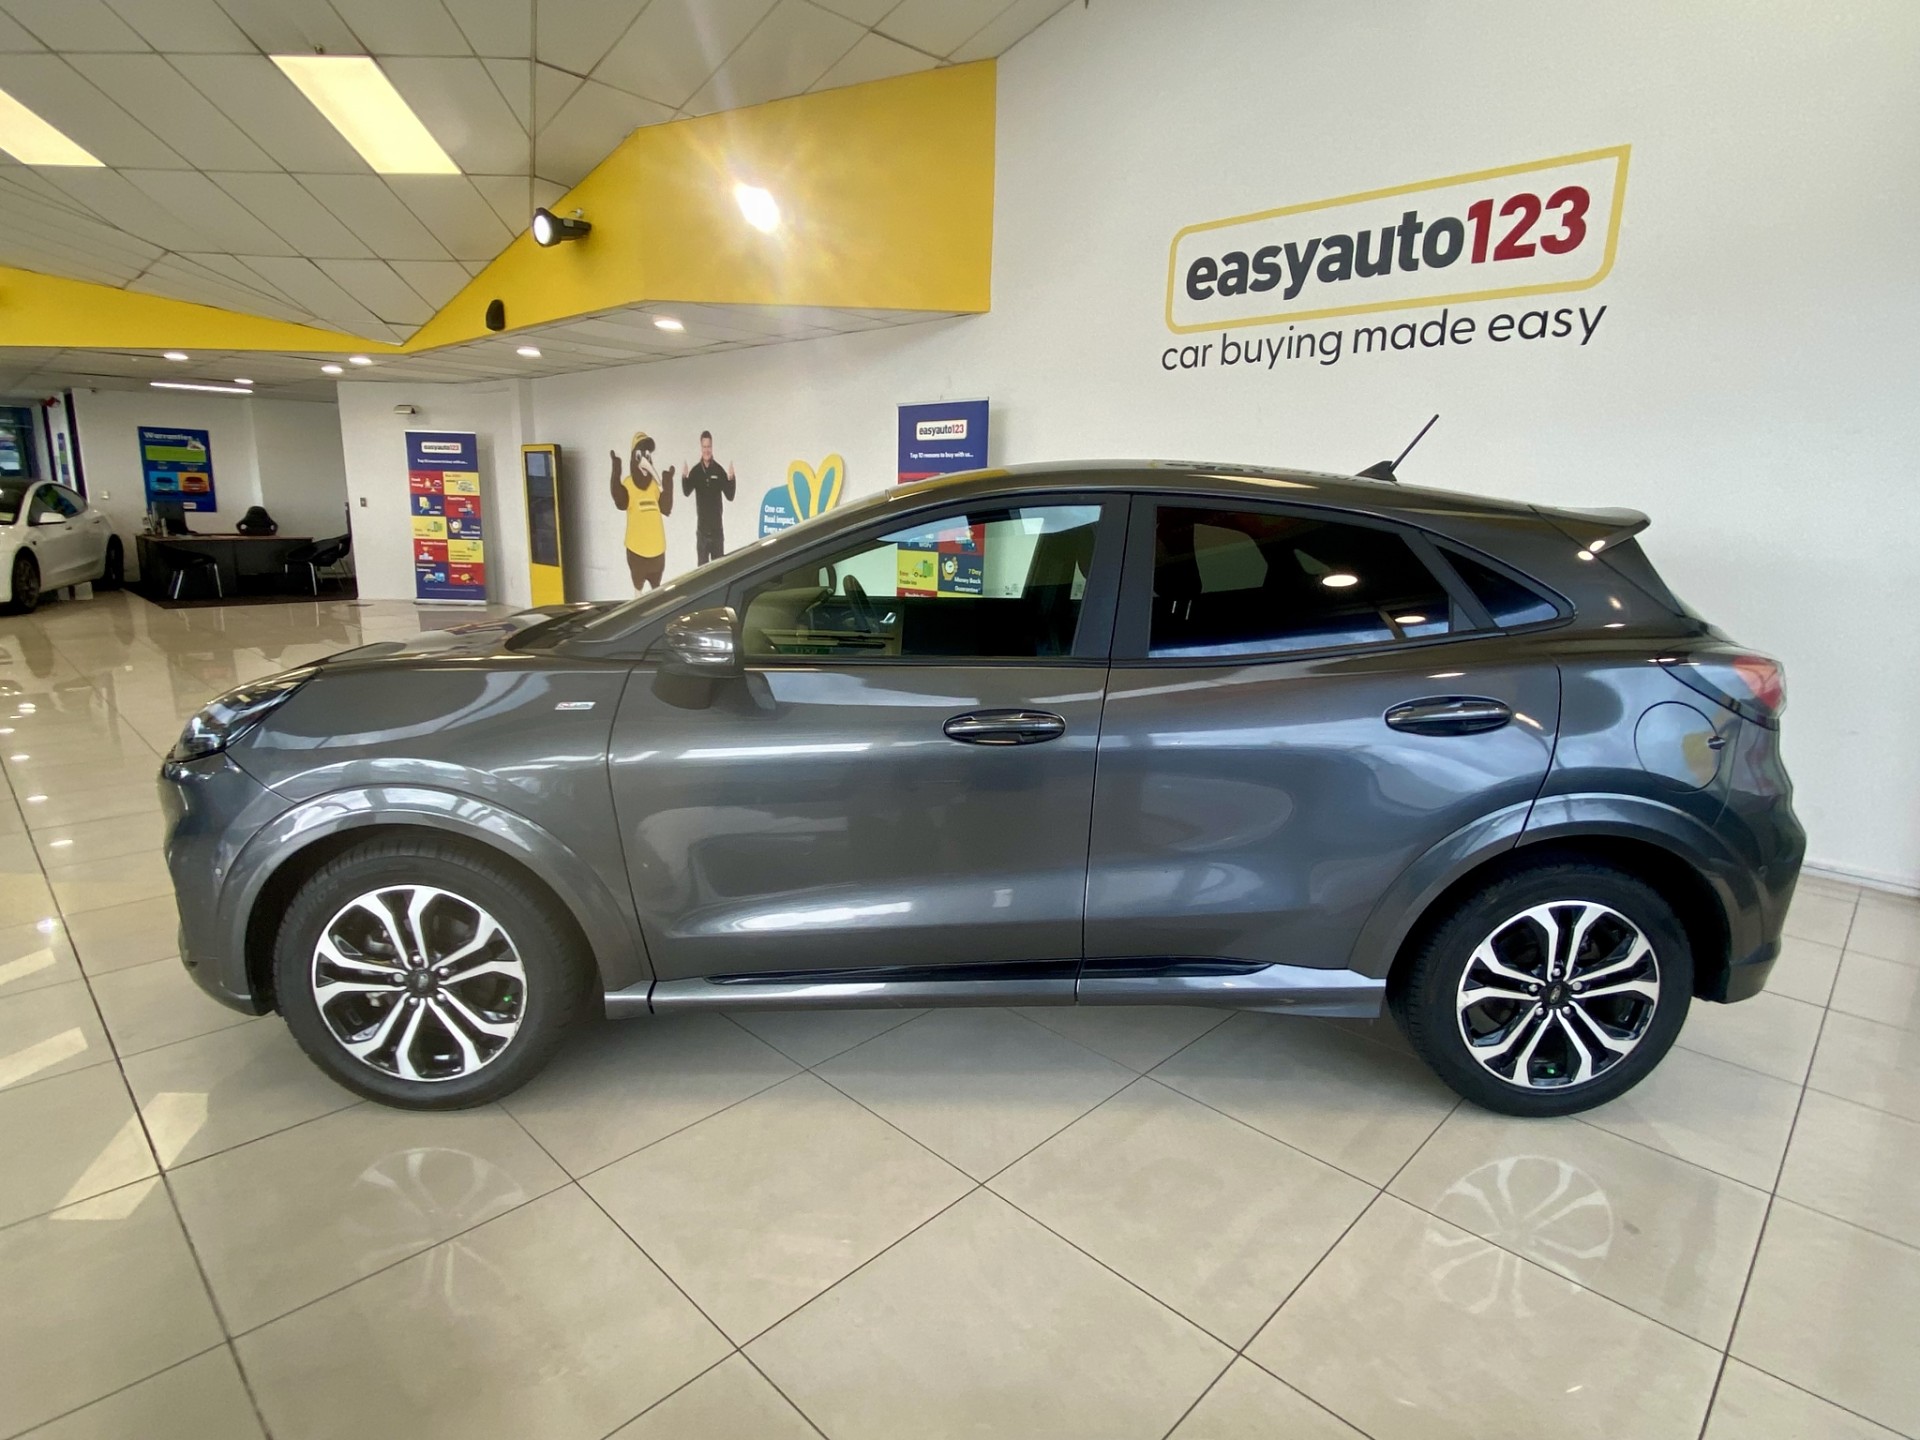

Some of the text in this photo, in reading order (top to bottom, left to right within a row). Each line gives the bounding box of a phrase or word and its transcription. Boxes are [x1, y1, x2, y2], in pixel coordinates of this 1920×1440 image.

[1186, 185, 1590, 300] easyauto123
[1161, 305, 1608, 370] car buying made easy
[919, 424, 965, 436] easyauto123
[764, 504, 775, 513] One
